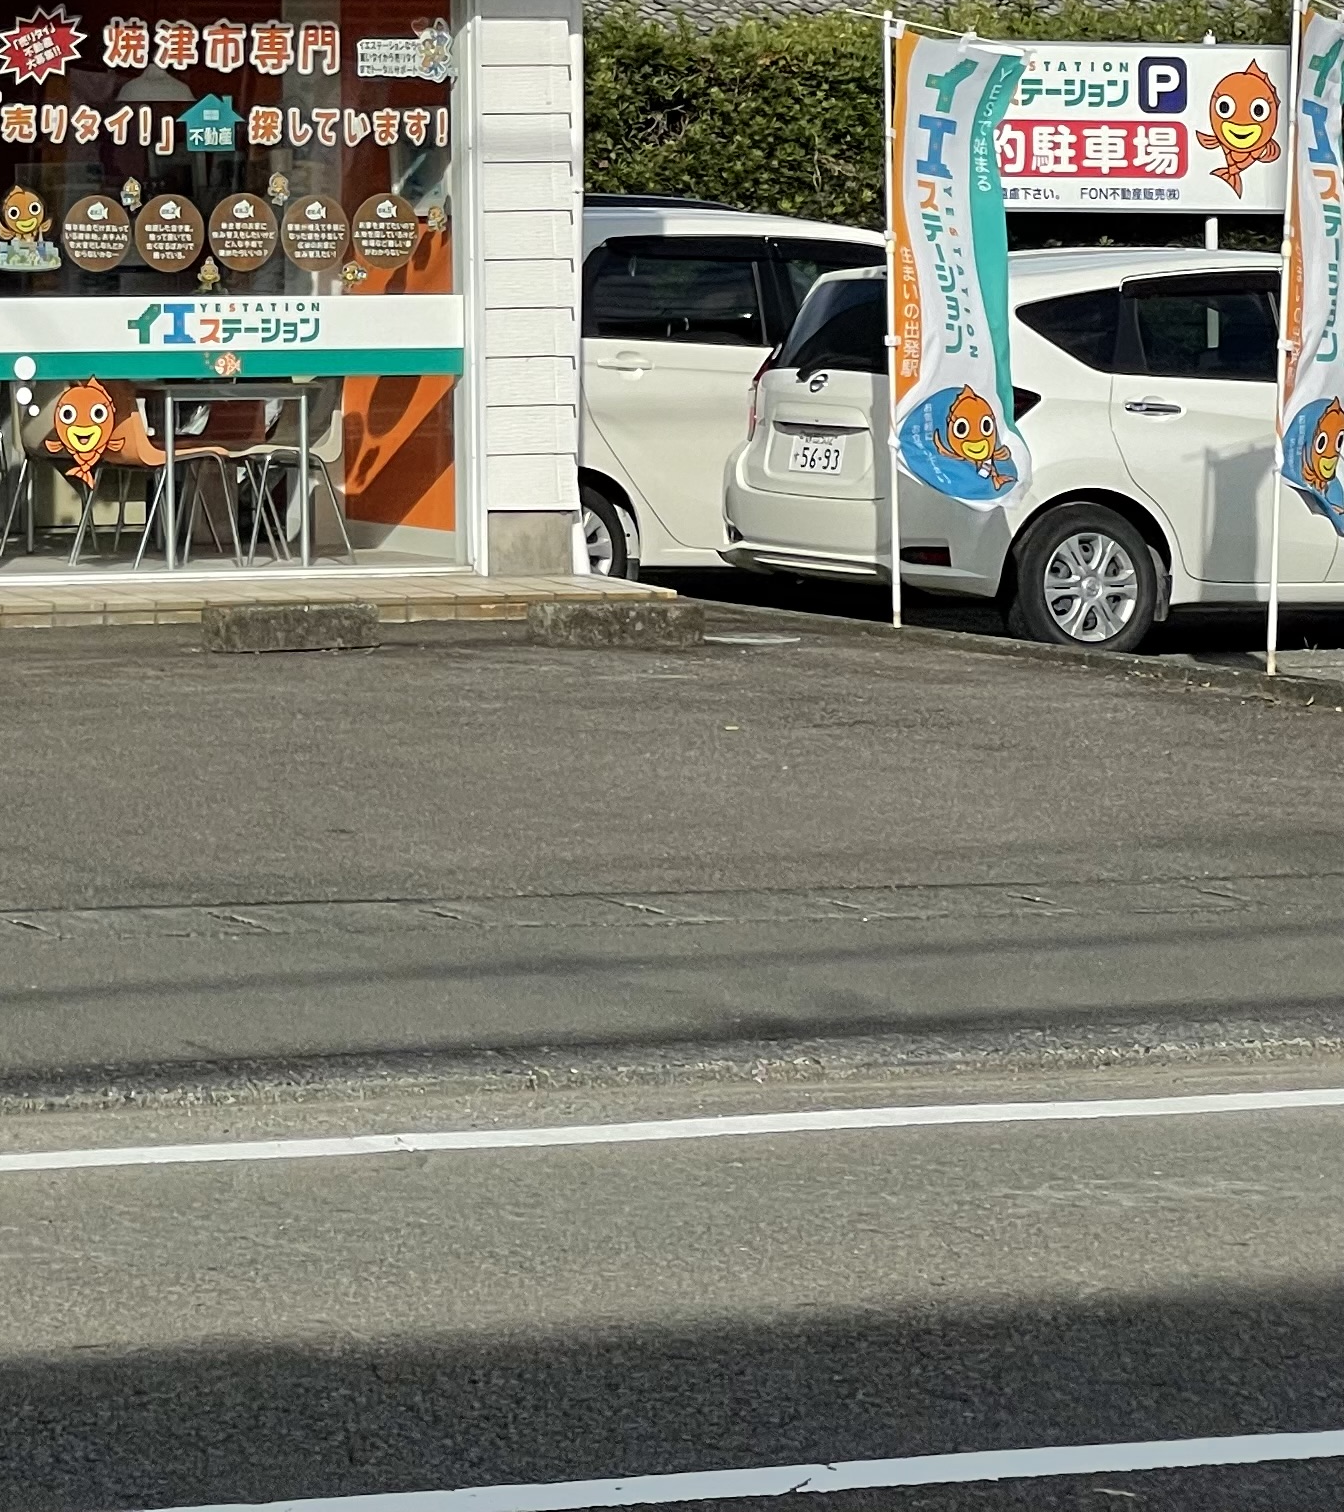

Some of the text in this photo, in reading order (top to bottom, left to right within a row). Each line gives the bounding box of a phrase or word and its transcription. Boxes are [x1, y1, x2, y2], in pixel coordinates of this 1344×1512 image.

[102, 16, 341, 75] 焼津市専門
[1010, 78, 1129, 107] テーション
[1148, 64, 1181, 108] P
[189, 127, 234, 147] 不動産
[246, 107, 449, 148] 探しています!
[916, 58, 979, 355] イエステーション
[127, 303, 320, 344] イエステーション
[200, 303, 320, 312] YESTATION
